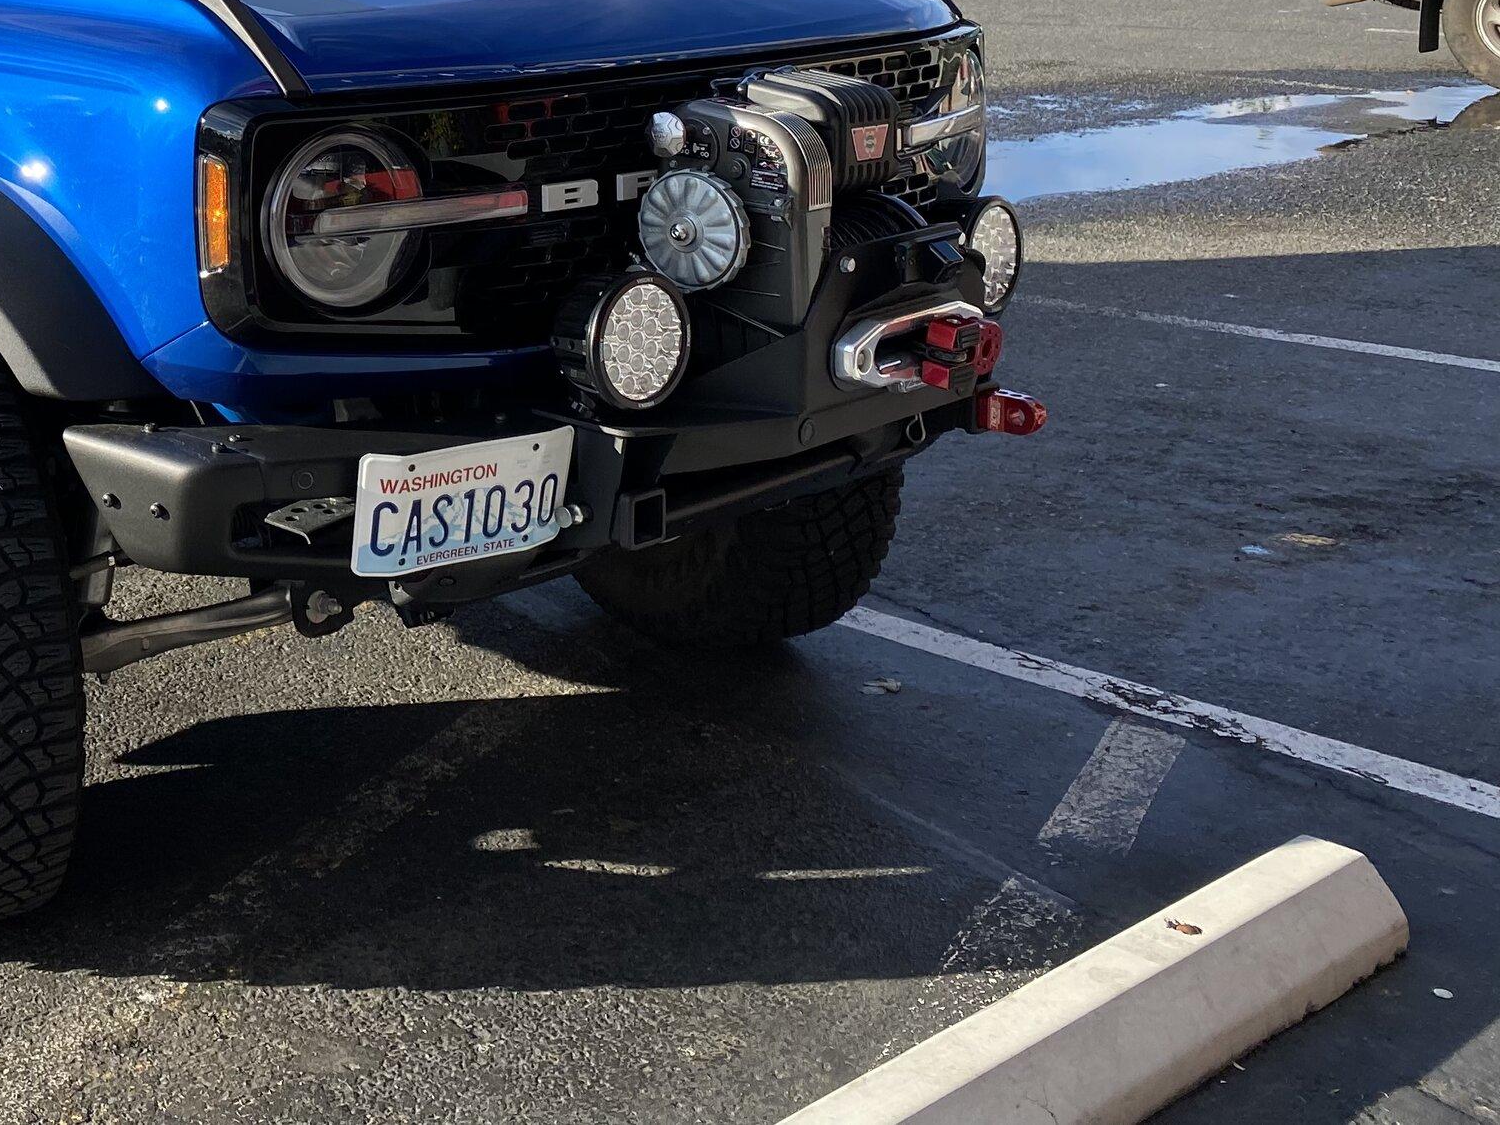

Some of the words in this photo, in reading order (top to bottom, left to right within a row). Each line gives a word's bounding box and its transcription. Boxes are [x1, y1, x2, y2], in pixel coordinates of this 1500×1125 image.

[380, 463, 498, 494] WASHINGTON
[369, 473, 559, 557] CAS1030
[416, 545, 478, 565] EVERGREEN
[483, 537, 515, 552] STATE
